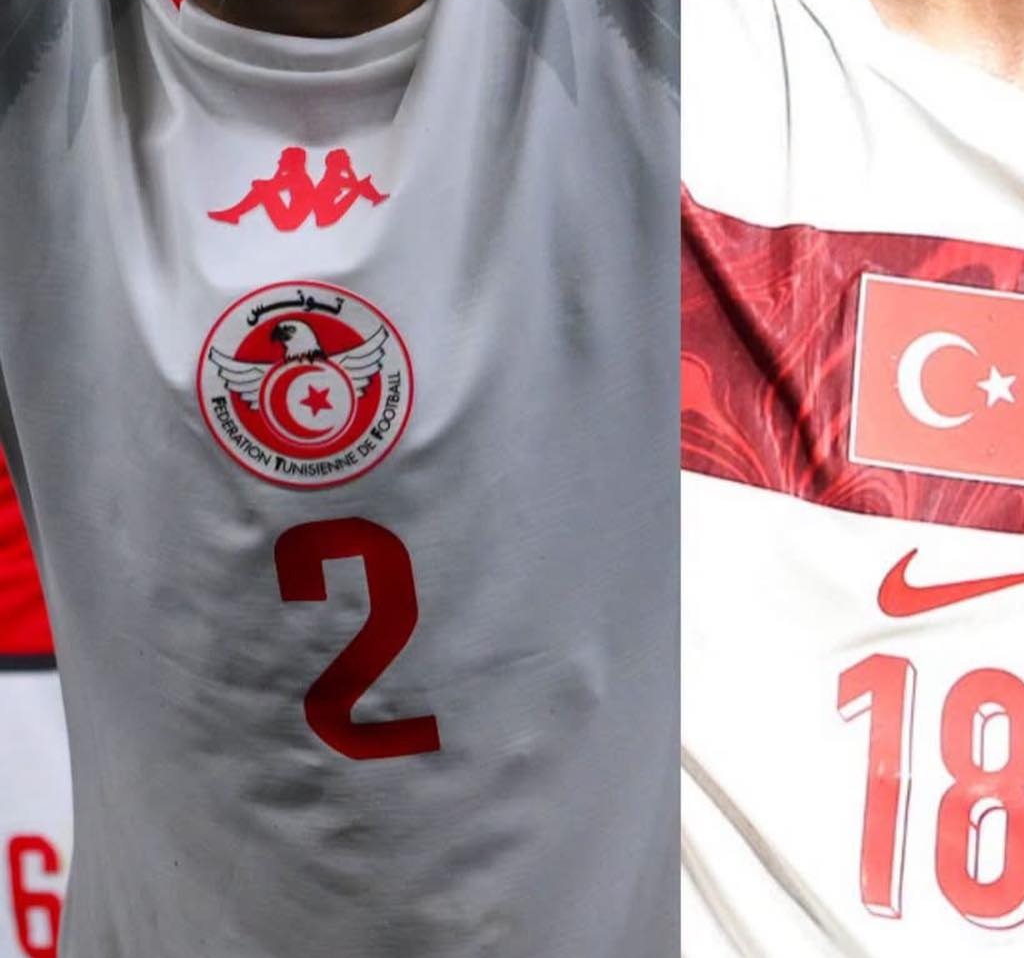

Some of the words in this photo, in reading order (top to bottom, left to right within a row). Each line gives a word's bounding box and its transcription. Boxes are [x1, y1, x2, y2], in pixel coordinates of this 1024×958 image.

[247, 290, 345, 326] تونس
[274, 516, 441, 760] 2
[8, 835, 62, 958] 6
